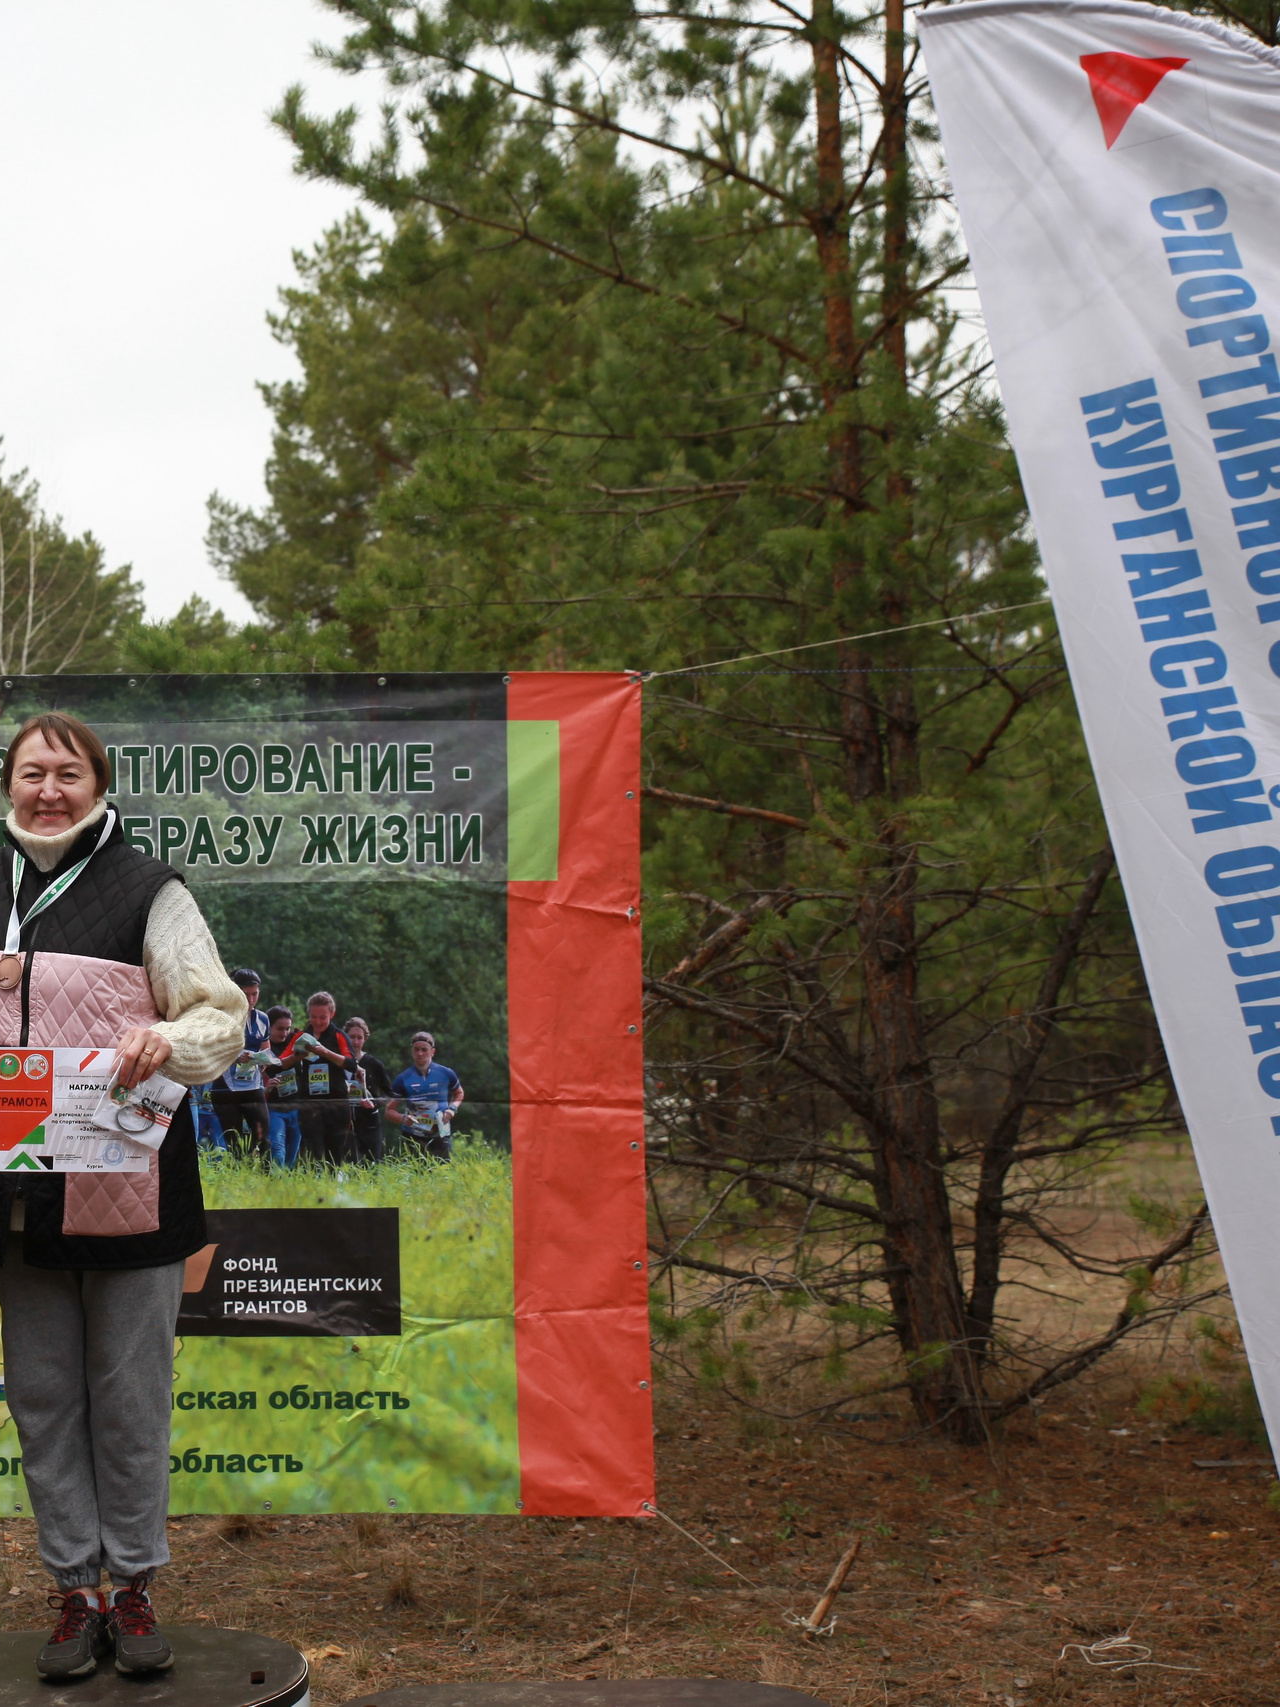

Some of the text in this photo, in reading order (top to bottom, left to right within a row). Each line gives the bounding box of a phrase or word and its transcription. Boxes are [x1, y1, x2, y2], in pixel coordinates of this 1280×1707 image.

[1150, 187, 1280, 681] СПОРТИВН
[1079, 377, 1280, 1137] КУРГАНСКОЙ ОБЛА
[122, 814, 284, 866] БРАЗУ
[300, 813, 482, 865] ЖИЗНИ
[280, 1075, 294, 1084] 504
[310, 1074, 327, 1082] 4501
[69, 1084, 108, 1092] НАГРАЖД
[223, 1257, 278, 1273] ФОНД
[223, 1278, 383, 1294] ПРЕЗИДЕНТСКИХ
[223, 1300, 308, 1314] ГРАНТОВ
[170, 1385, 411, 1411] ская область
[169, 1447, 303, 1474] область
